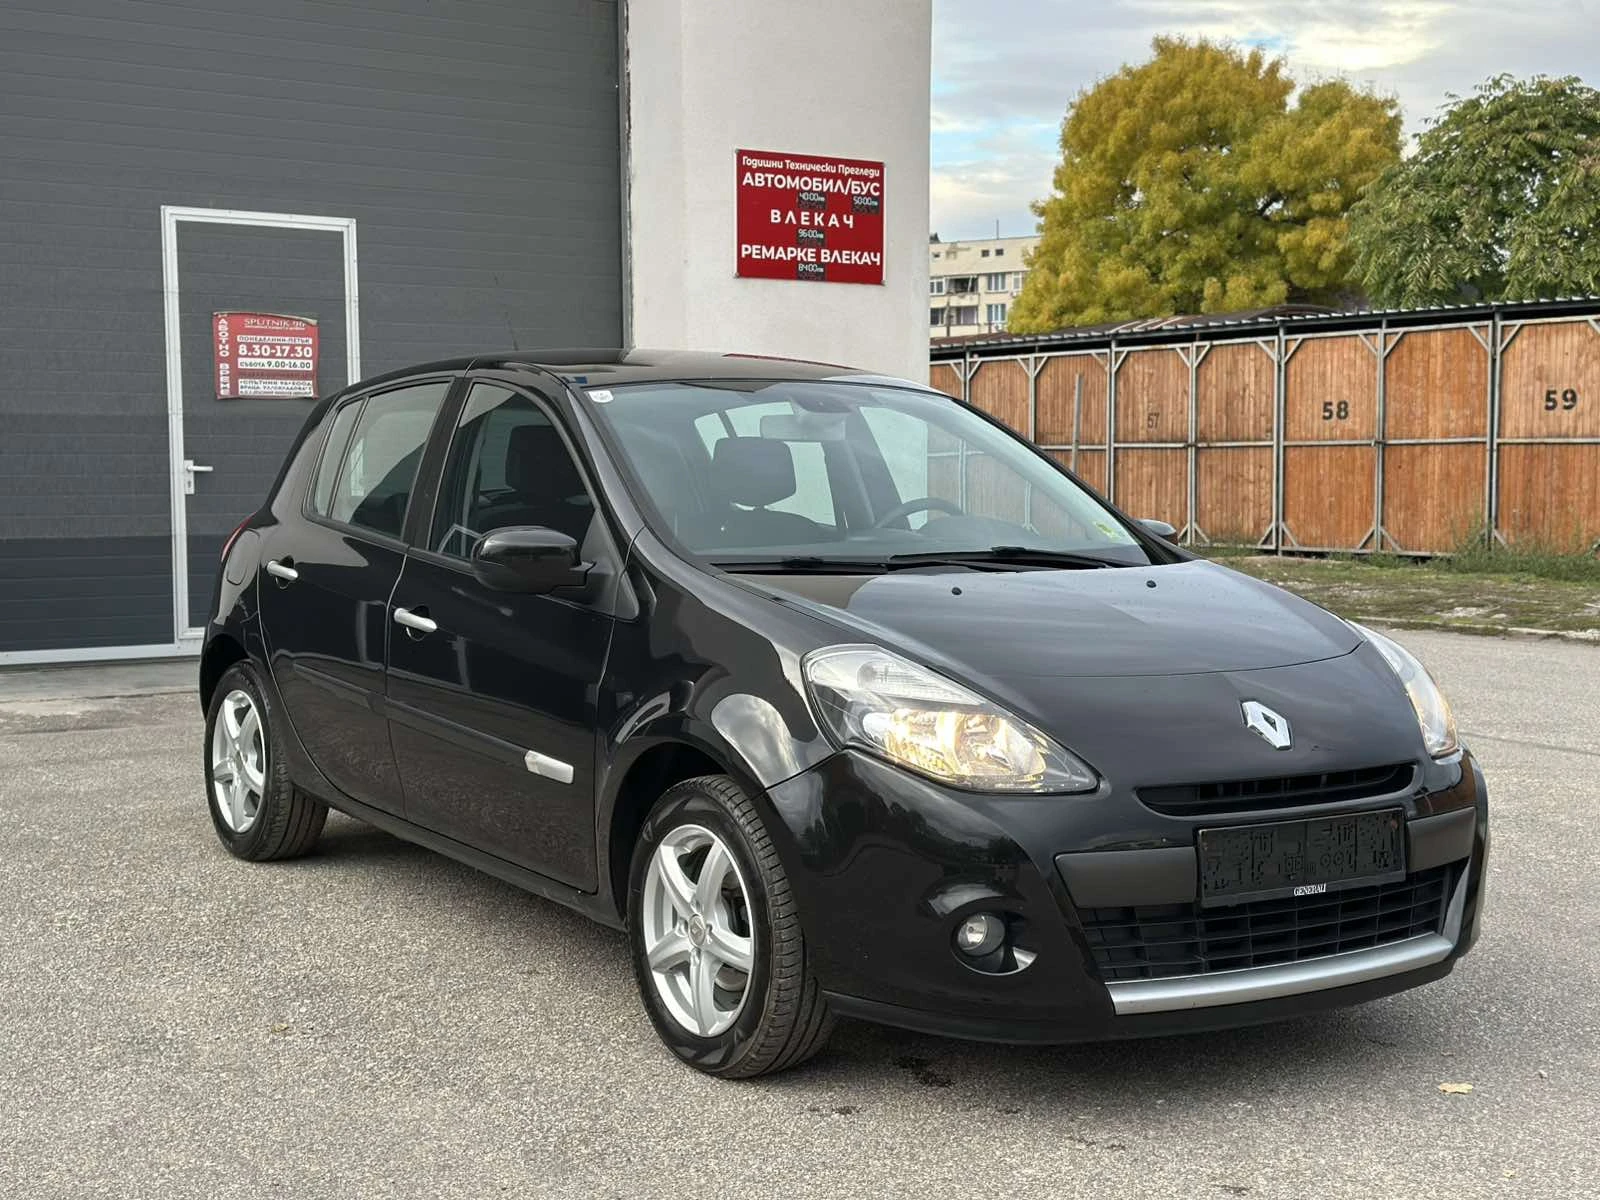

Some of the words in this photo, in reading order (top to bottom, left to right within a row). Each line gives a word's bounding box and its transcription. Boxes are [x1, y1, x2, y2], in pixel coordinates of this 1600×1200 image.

[742, 156, 783, 169] Годишни
[785, 159, 837, 174] Технически
[838, 164, 880, 179] Прегледи
[742, 172, 880, 196] АВТОМОБИЛ/БУС
[741, 244, 816, 262] РЕМАРКЕ
[820, 248, 881, 266] ВЛЕКАЧ
[238, 344, 312, 358] 8.30-17.30
[267, 360, 311, 369] 9.00-16.00
[1544, 389, 1577, 411] 59
[1322, 401, 1349, 420] 58
[1146, 412, 1160, 429] 57
[1293, 883, 1326, 896] GENERALI
